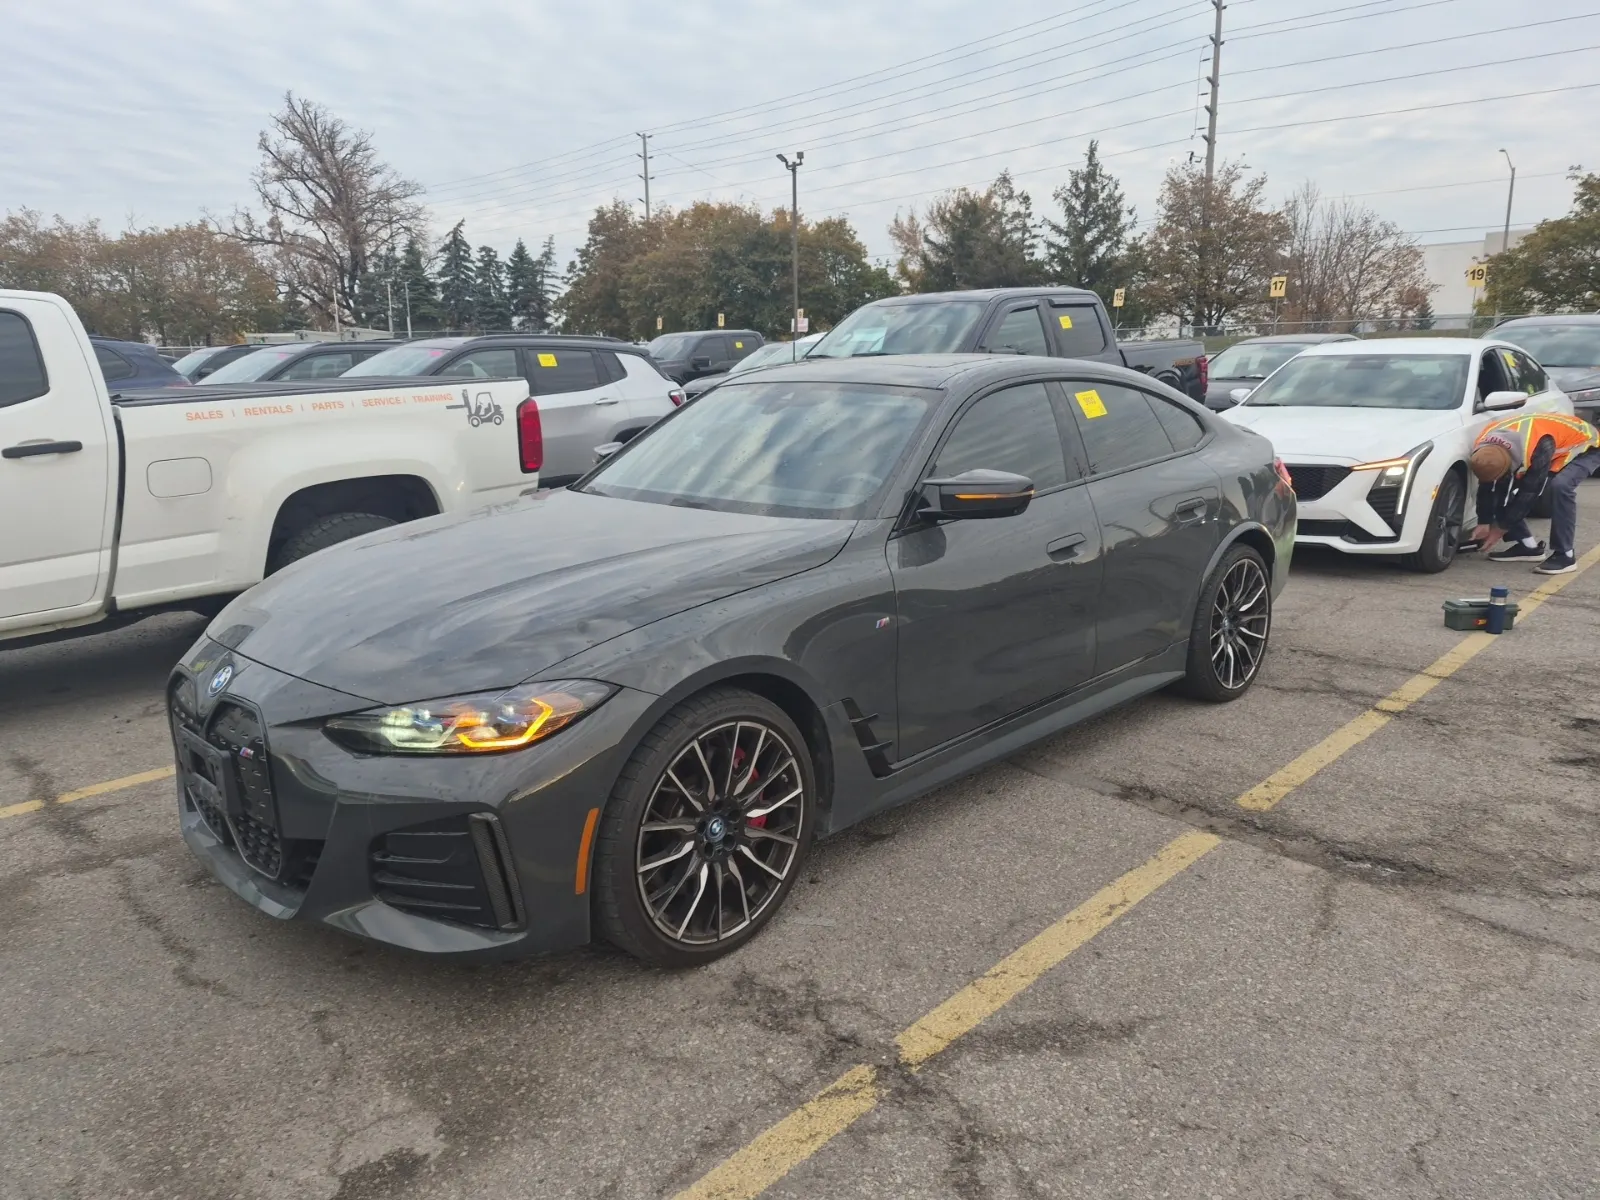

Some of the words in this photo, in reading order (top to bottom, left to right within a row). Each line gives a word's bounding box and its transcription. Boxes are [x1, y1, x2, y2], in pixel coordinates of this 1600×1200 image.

[1470, 268, 1485, 281] 19
[1272, 280, 1285, 291] 17
[1115, 291, 1124, 302] 15
[185, 410, 224, 421] SALES
[244, 404, 293, 416] RENTALS
[311, 400, 345, 411] PARTS
[361, 395, 401, 407] SERVICE
[411, 392, 453, 403] TRAINING
